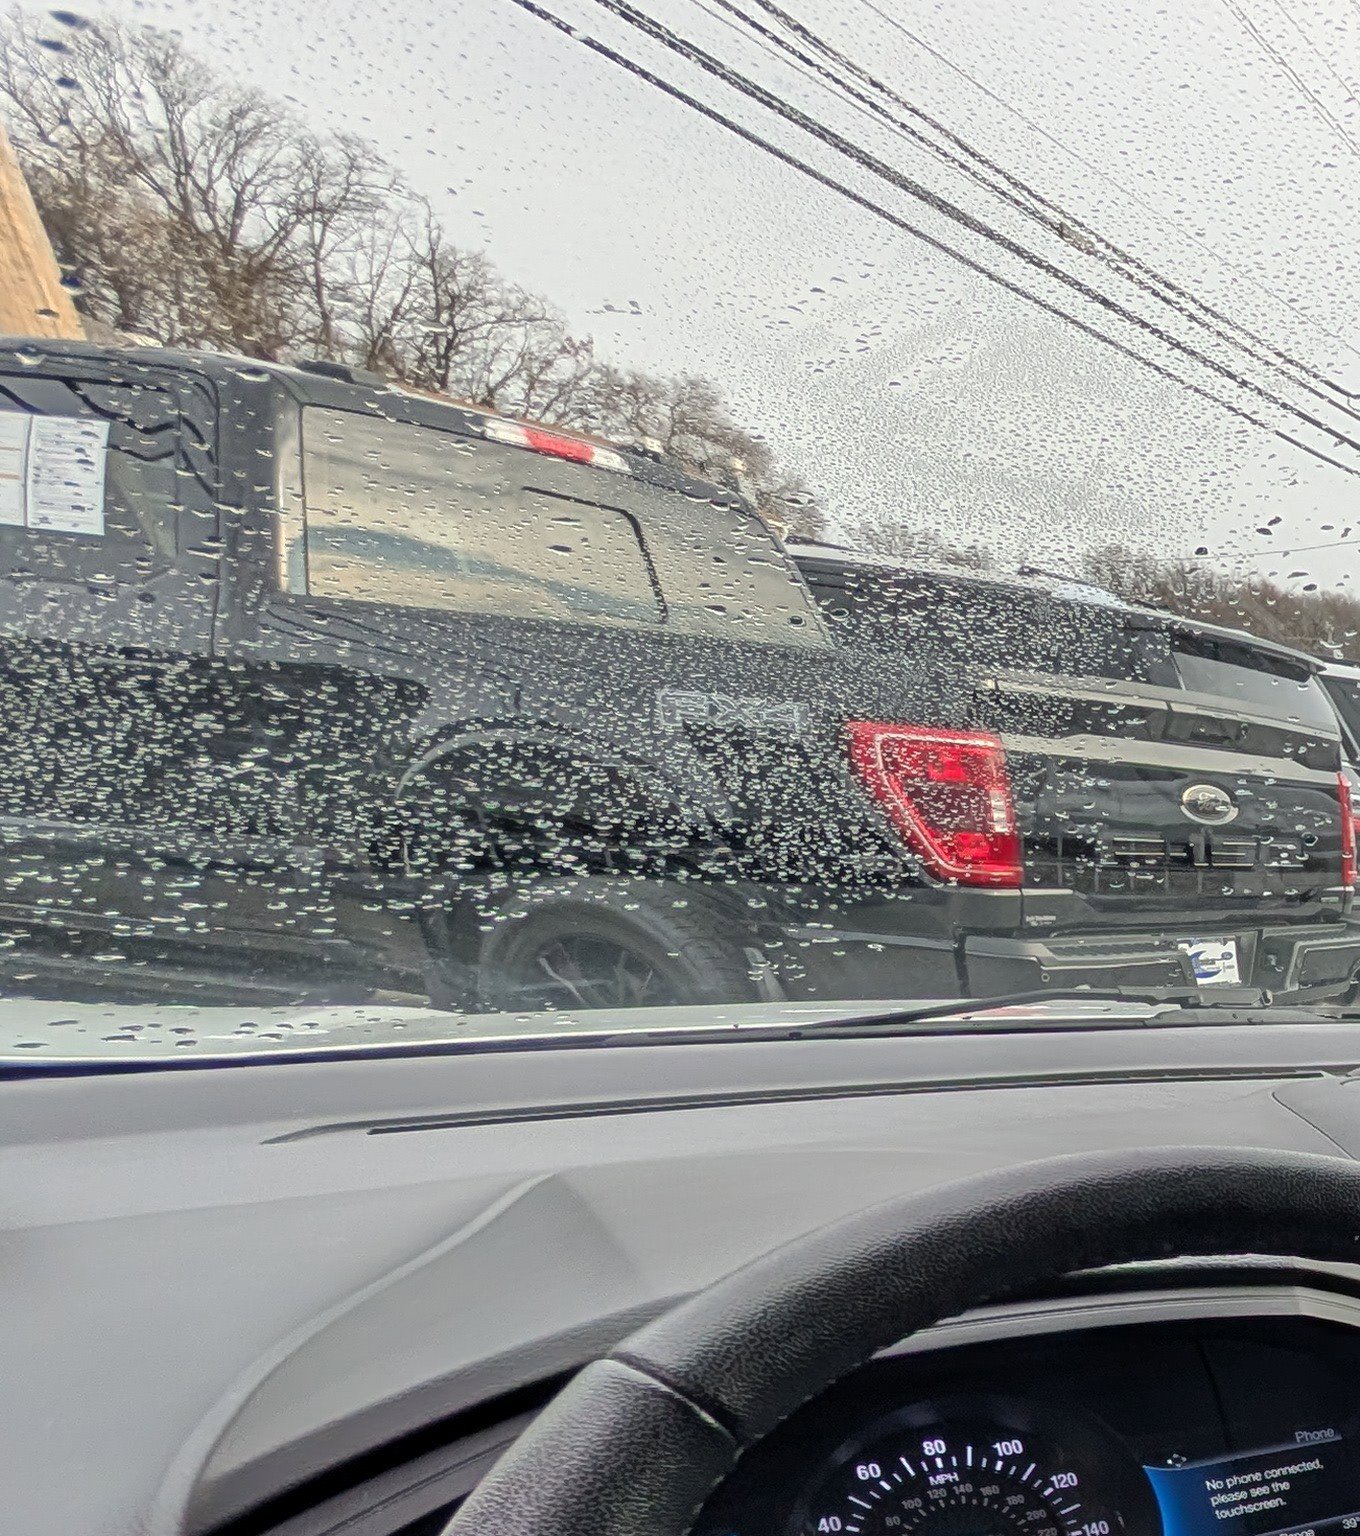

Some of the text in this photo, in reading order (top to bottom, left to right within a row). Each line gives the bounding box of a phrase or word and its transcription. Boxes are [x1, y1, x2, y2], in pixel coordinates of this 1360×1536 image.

[1295, 1428, 1335, 1442] Phone
[922, 1439, 947, 1456] 80
[992, 1439, 1024, 1457] 100
[856, 1462, 882, 1481] 60
[928, 1472, 959, 1487] MPH
[953, 1483, 973, 1495] 140
[1050, 1472, 1078, 1490] 120
[1205, 1478, 1224, 1491] No
[1226, 1471, 1262, 1490] phone
[927, 1488, 947, 1499] 120
[1210, 1480, 1291, 1507] please see the
[901, 1498, 923, 1510] 100
[1215, 1498, 1287, 1520] touchscreen.
[885, 1515, 900, 1526] 80
[1026, 1509, 1047, 1521] 200
[817, 1516, 842, 1533] 40
[1081, 1520, 1110, 1536] 140
